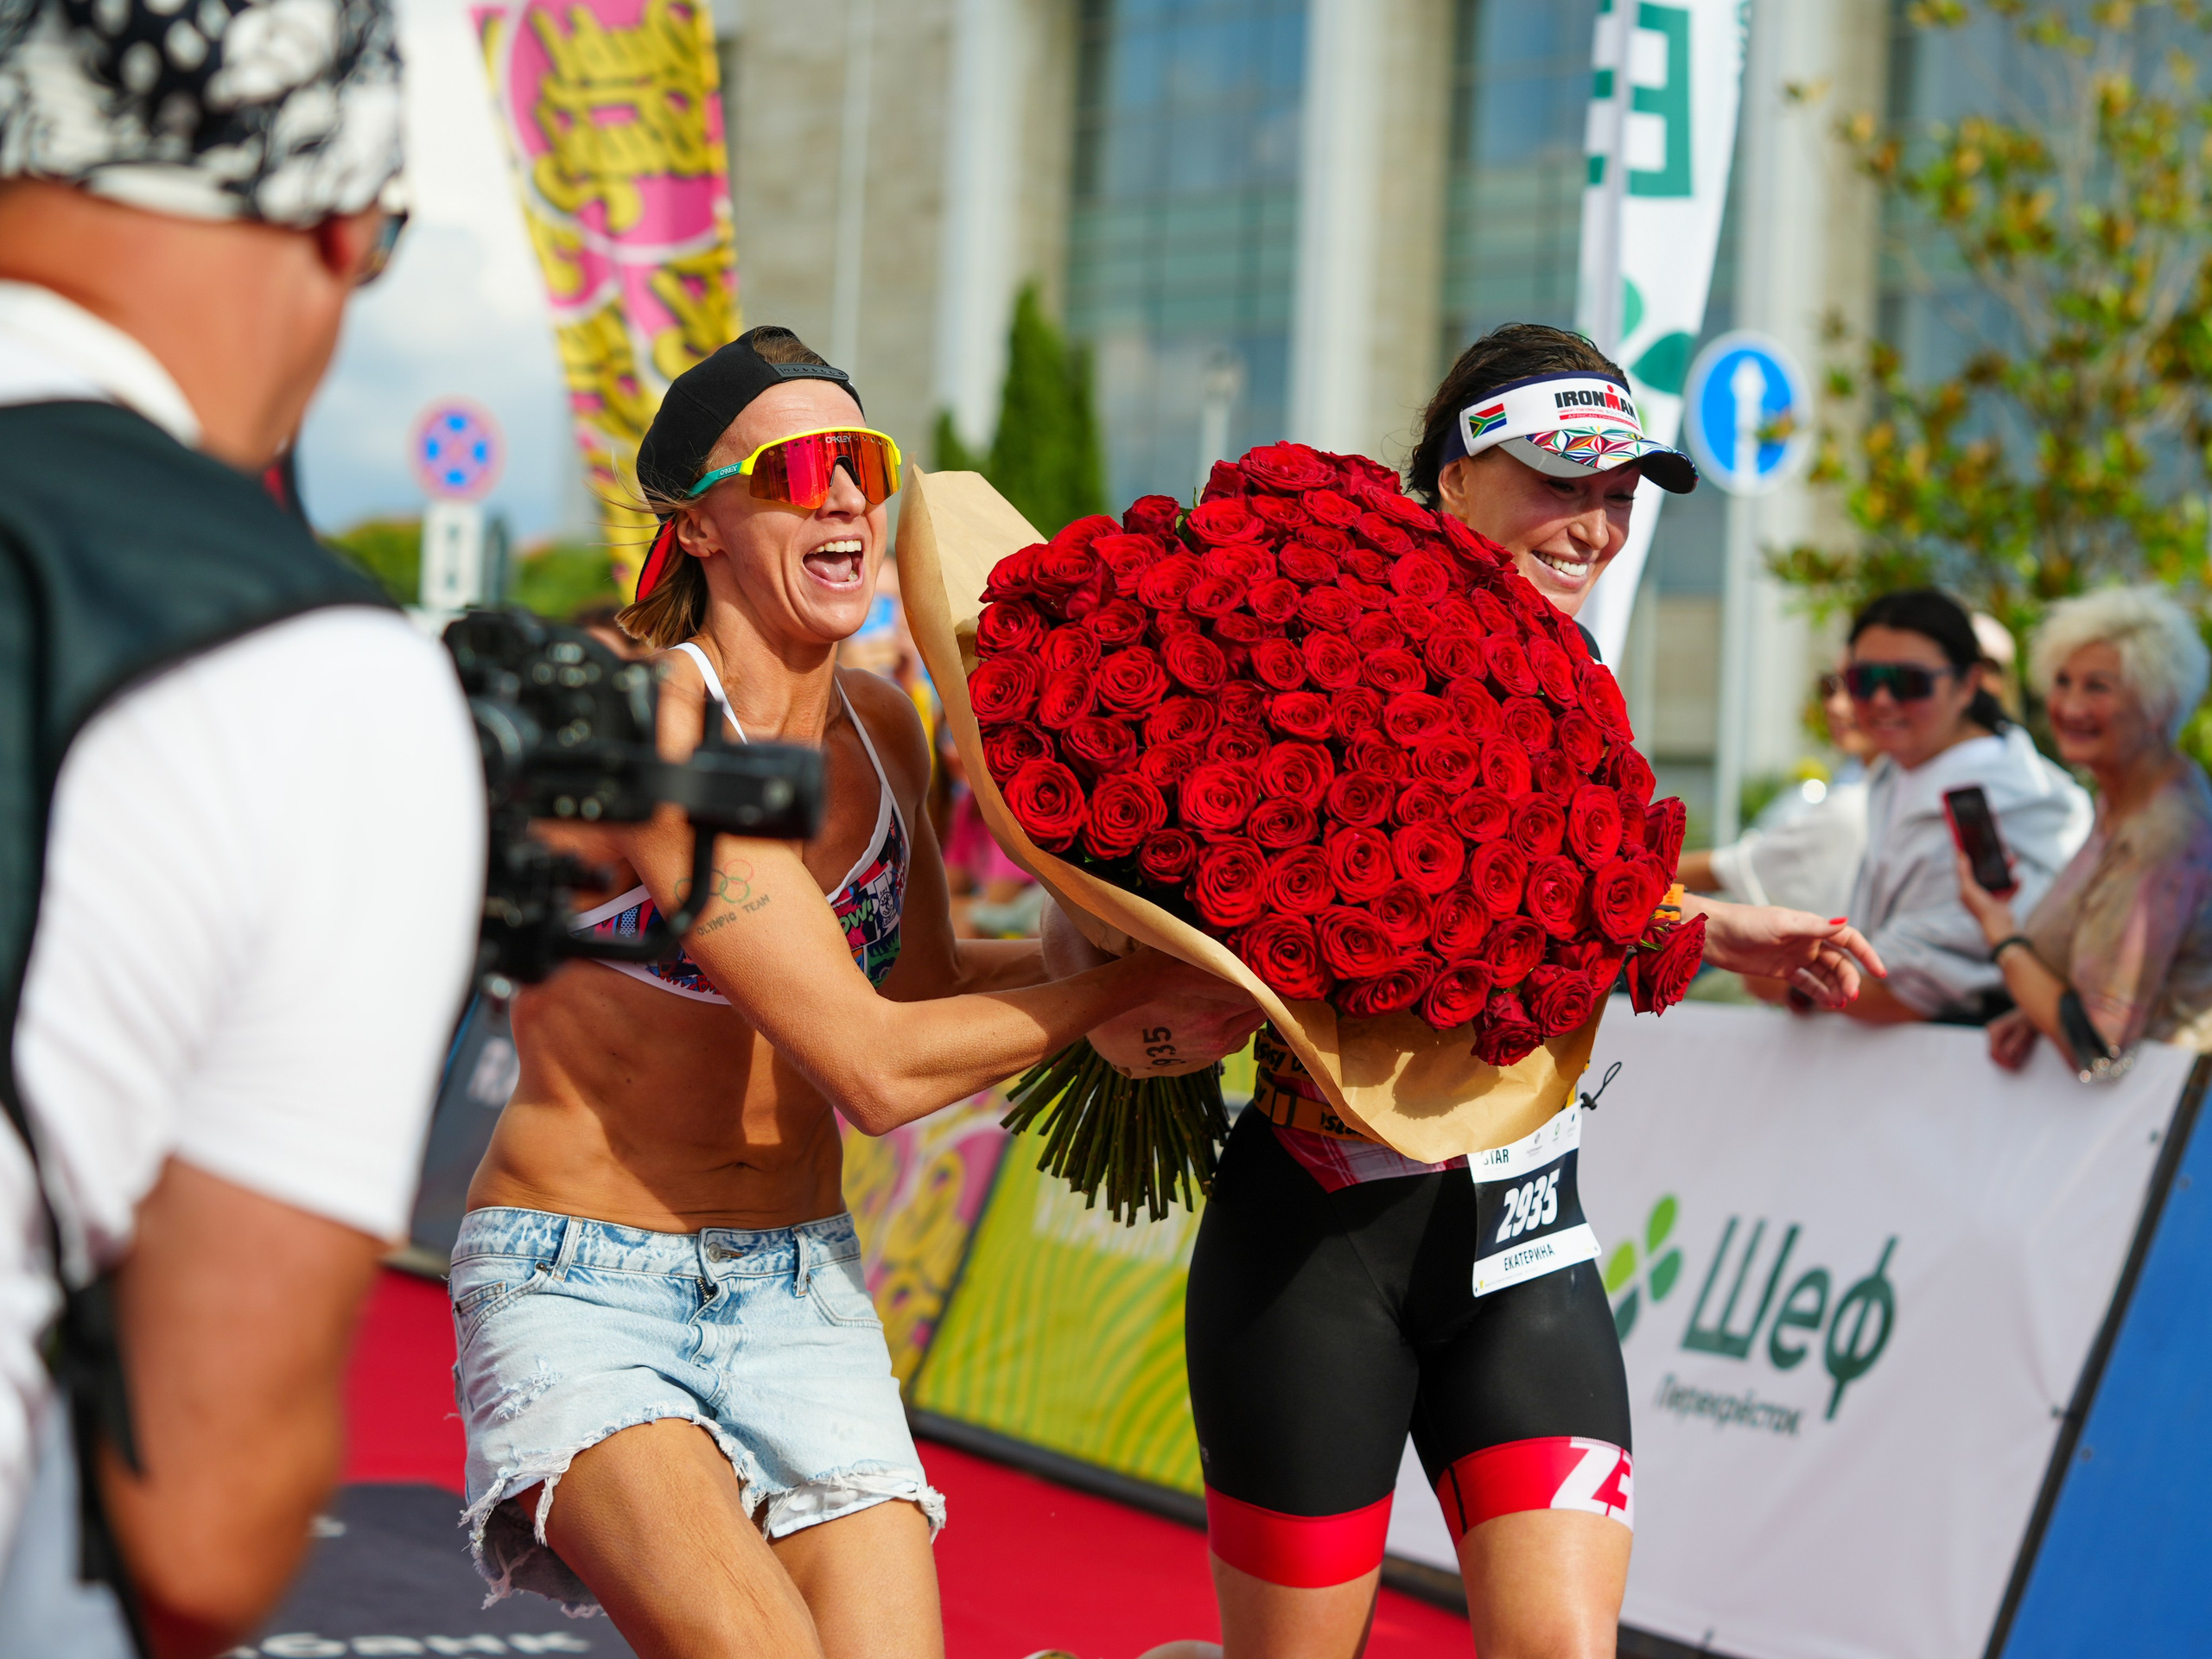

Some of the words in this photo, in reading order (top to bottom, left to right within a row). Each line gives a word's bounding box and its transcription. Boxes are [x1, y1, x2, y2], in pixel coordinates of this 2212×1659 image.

[1554, 385, 1637, 421] IRONMAN
[742, 893, 771, 913] TEAM
[838, 899, 874, 934] OW!
[1496, 1167, 1560, 1244] 2935
[1503, 1243, 1555, 1271] ЕКАТЕРИНА
[1679, 1215, 1900, 1424] Шеф
